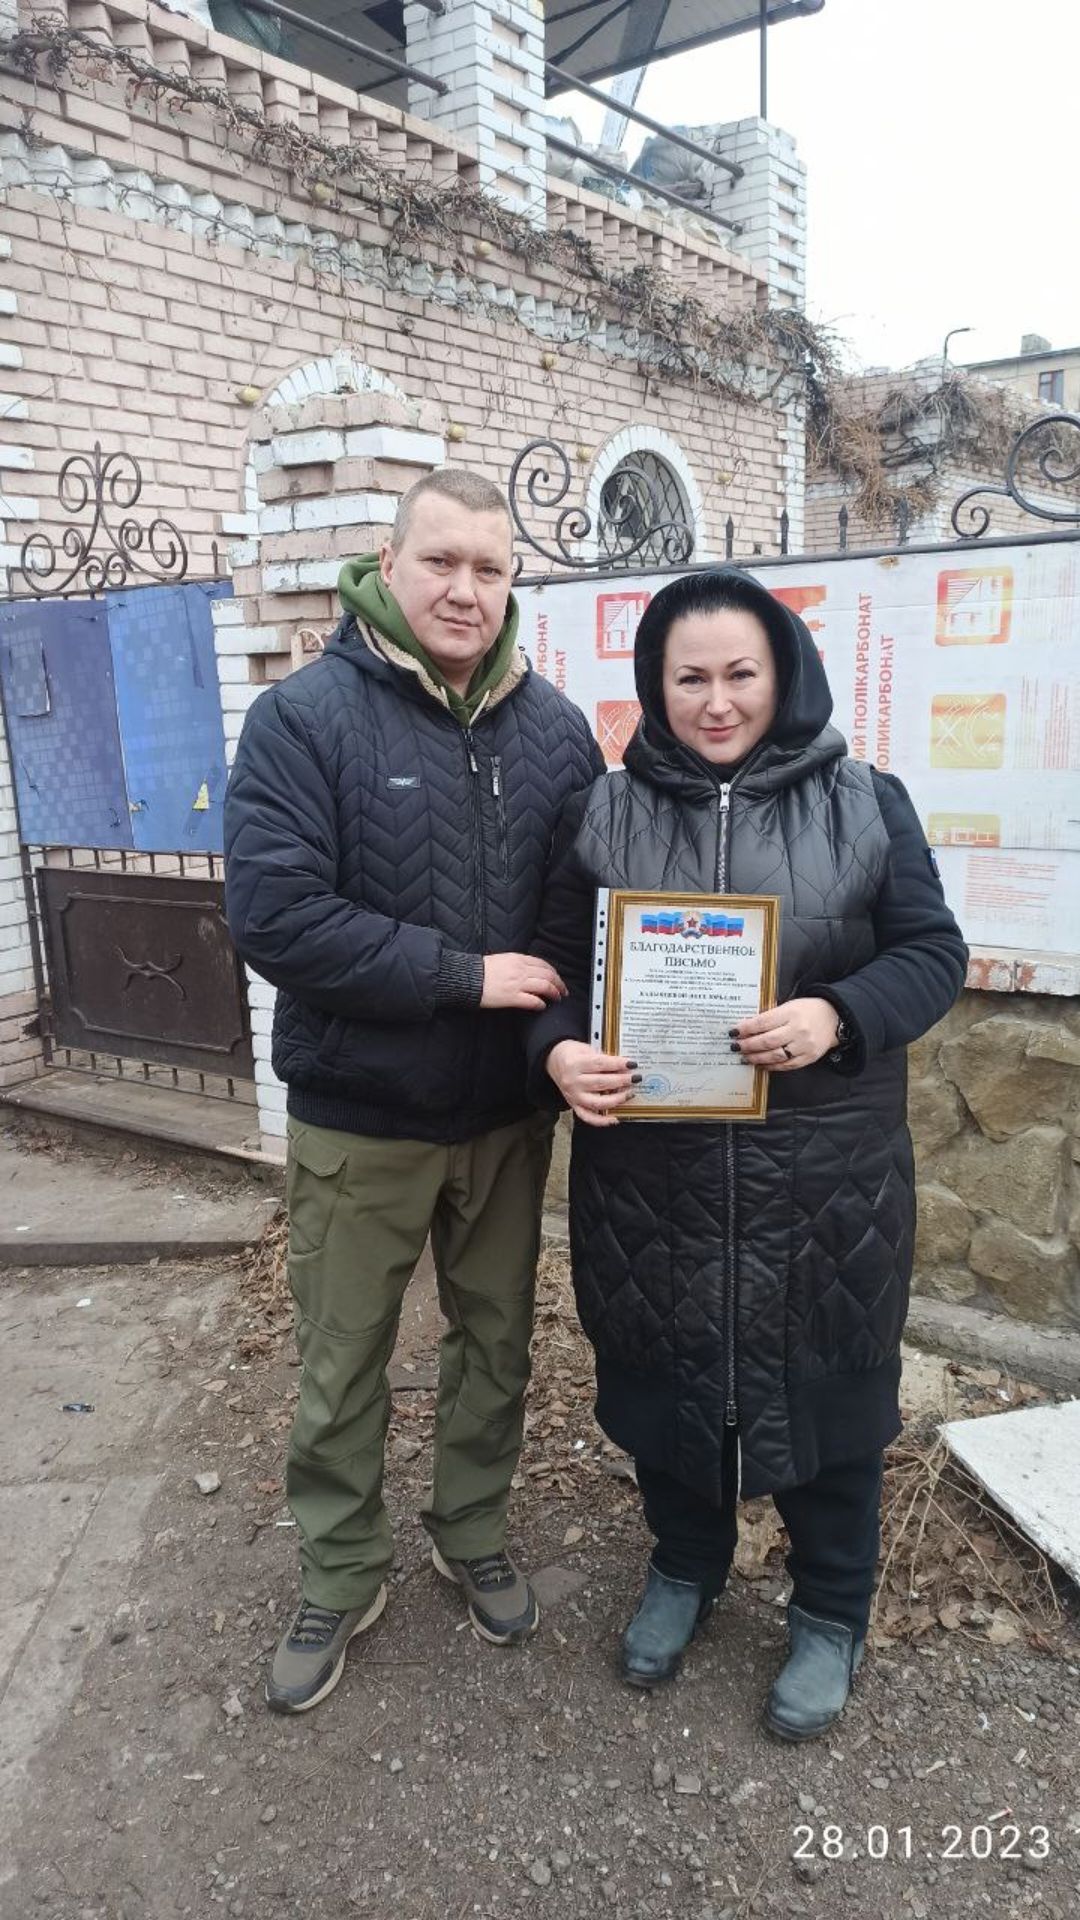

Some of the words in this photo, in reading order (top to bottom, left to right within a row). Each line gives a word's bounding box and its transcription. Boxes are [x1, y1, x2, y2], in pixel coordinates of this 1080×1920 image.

[556, 649, 566, 694] ОНАТ
[854, 593, 872, 729] ПОЛІКАРБОНАТ
[629, 941, 756, 956] БЛАГОДАРСТВЕННОЕ
[664, 956, 716, 968] ПИСЬМО
